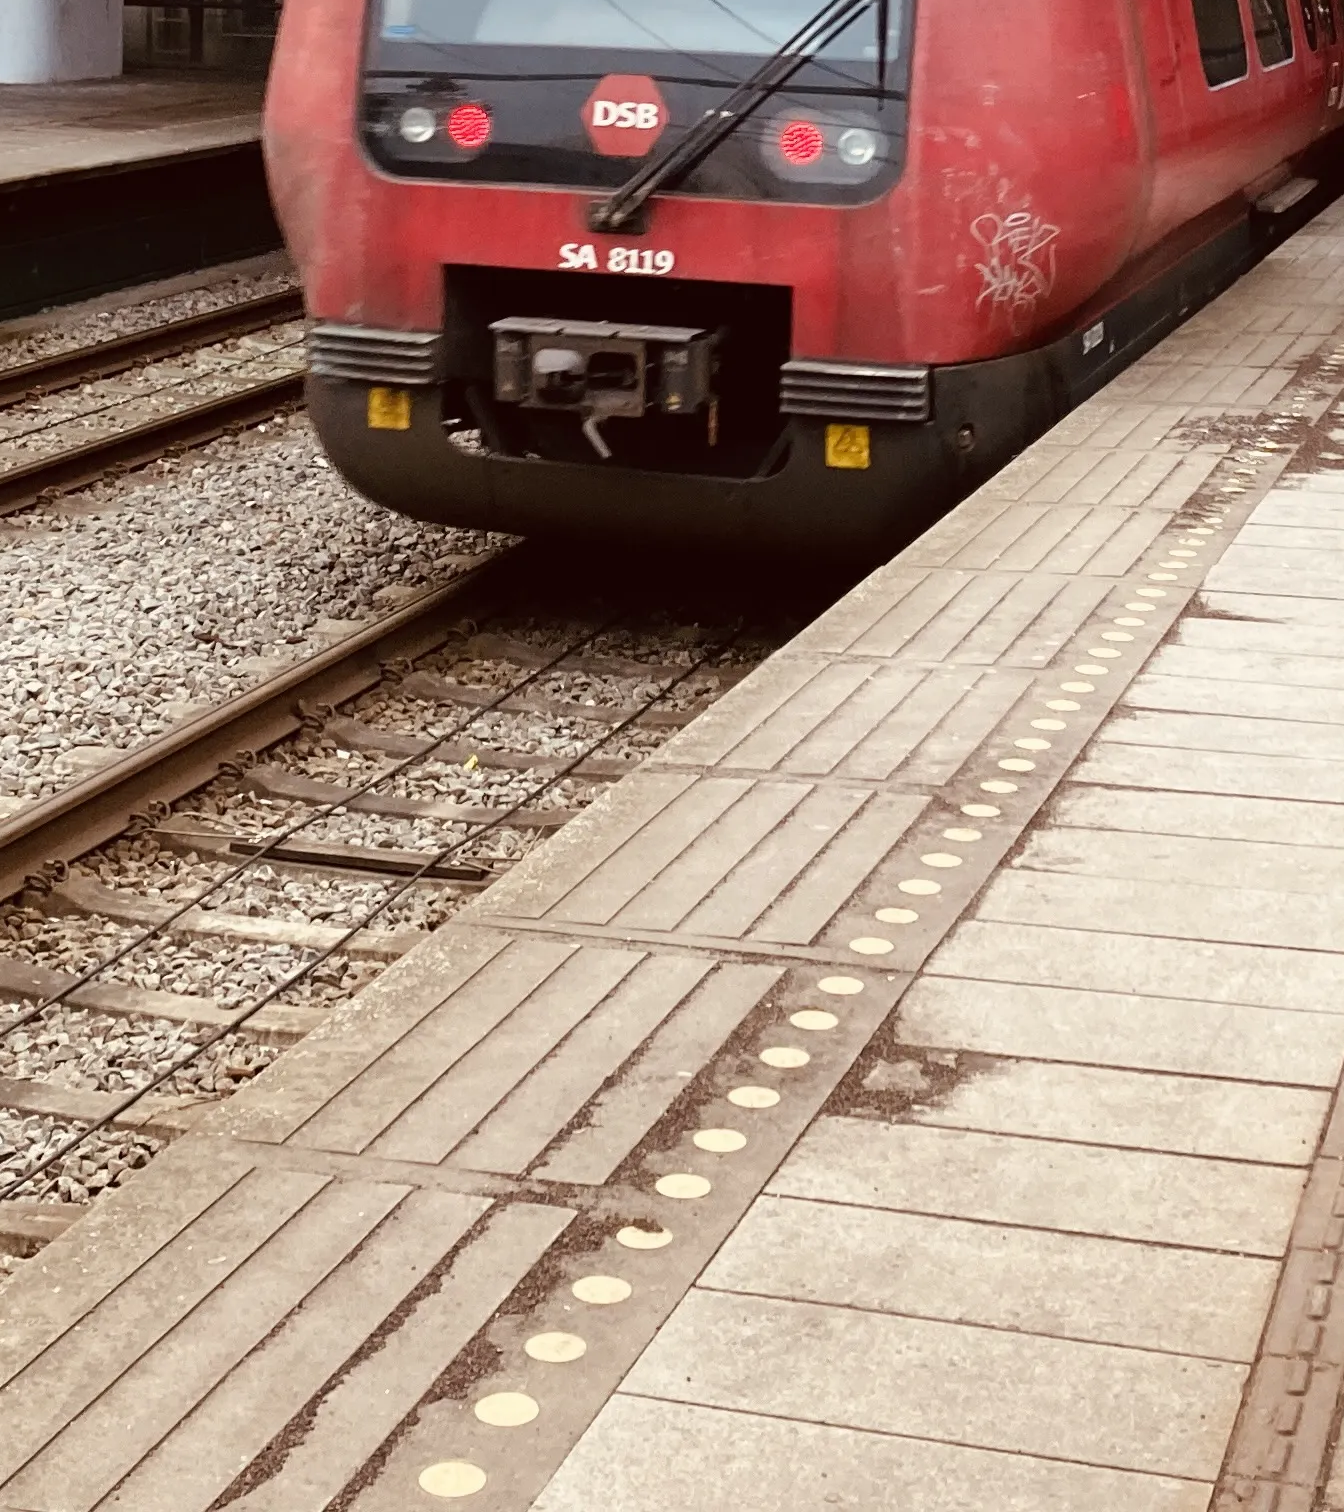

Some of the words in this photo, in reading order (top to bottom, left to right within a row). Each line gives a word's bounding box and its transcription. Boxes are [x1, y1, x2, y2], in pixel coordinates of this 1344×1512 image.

[591, 100, 659, 130] DSB
[558, 243, 599, 270] SA
[606, 247, 675, 276] 8119
